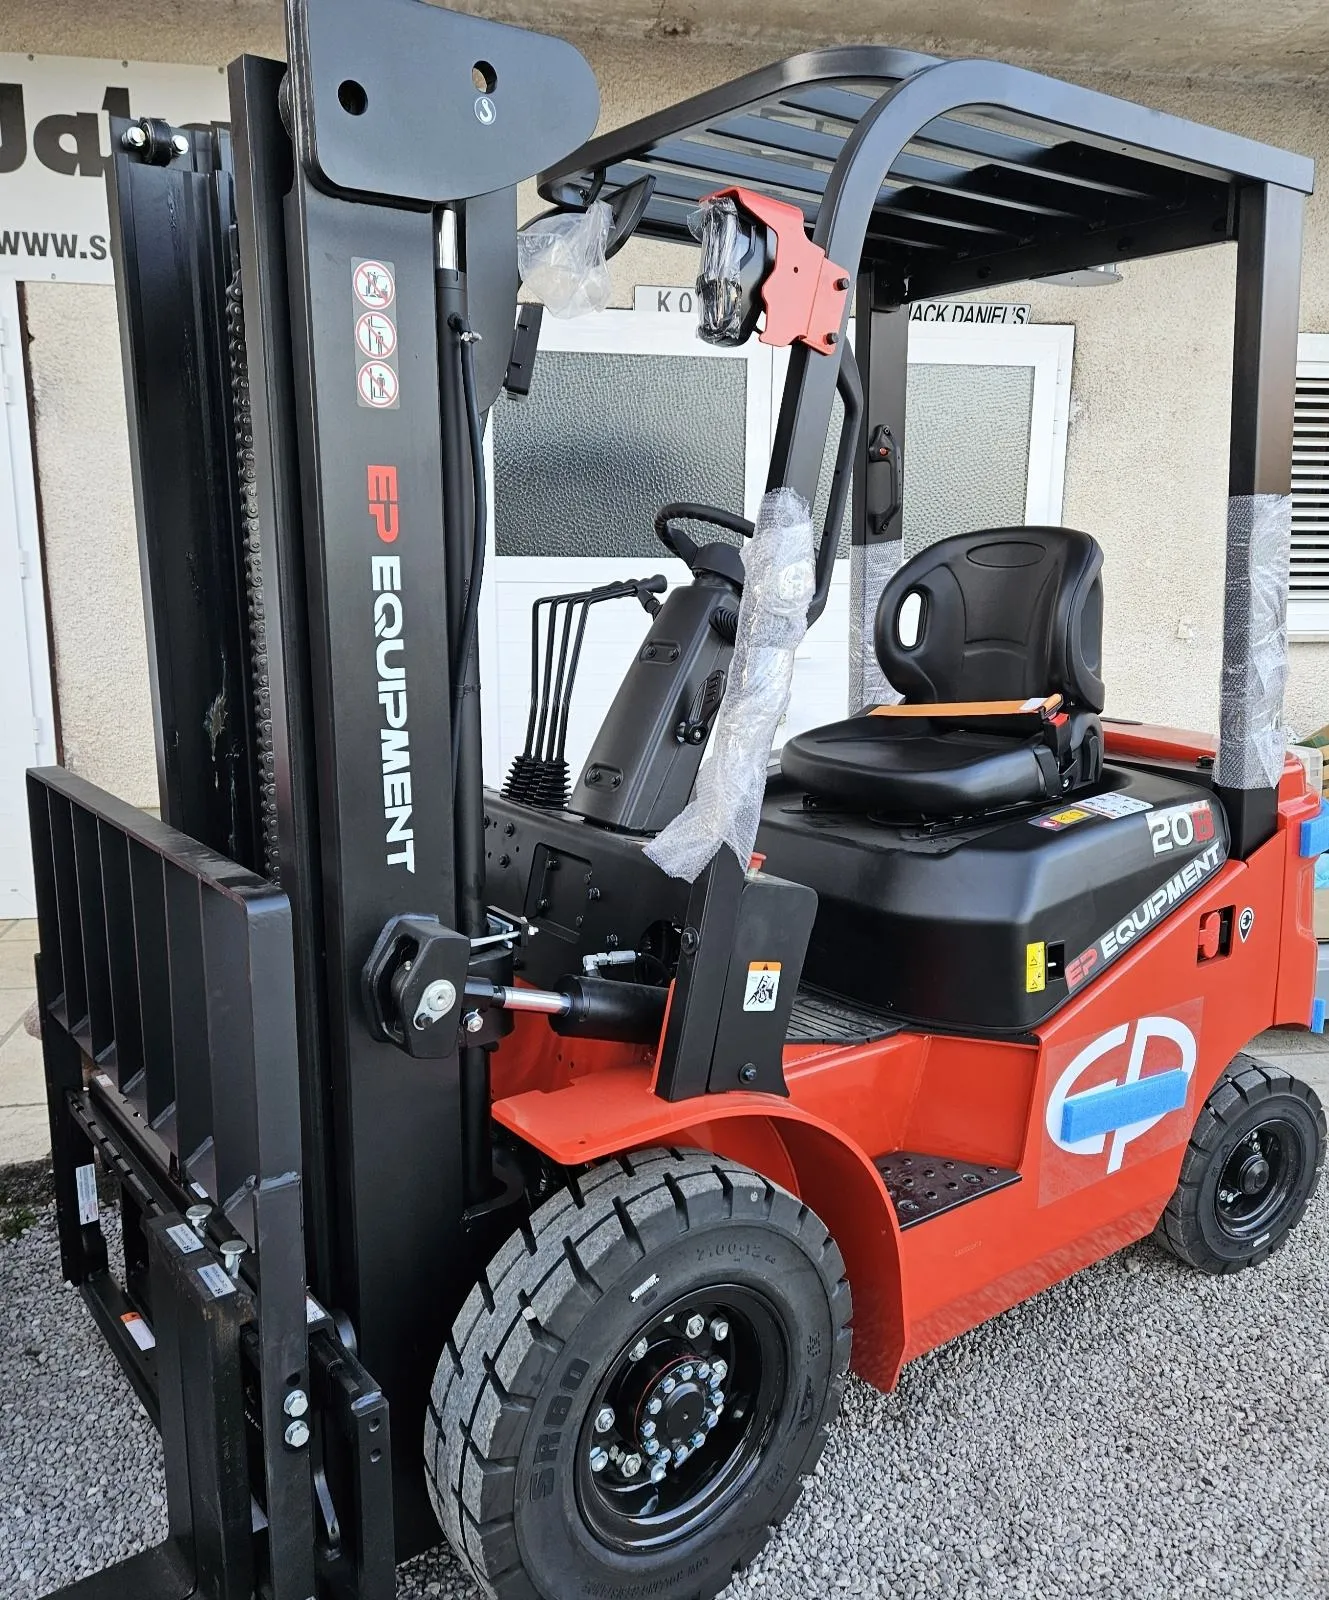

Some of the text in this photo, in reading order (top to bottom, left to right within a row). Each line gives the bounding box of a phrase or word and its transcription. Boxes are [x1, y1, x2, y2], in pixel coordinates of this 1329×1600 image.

[951, 304, 1026, 324] DANIEL'S
[367, 464, 415, 874] EP EQUIPMENT
[1064, 841, 1221, 988] EP EQUIPMENT
